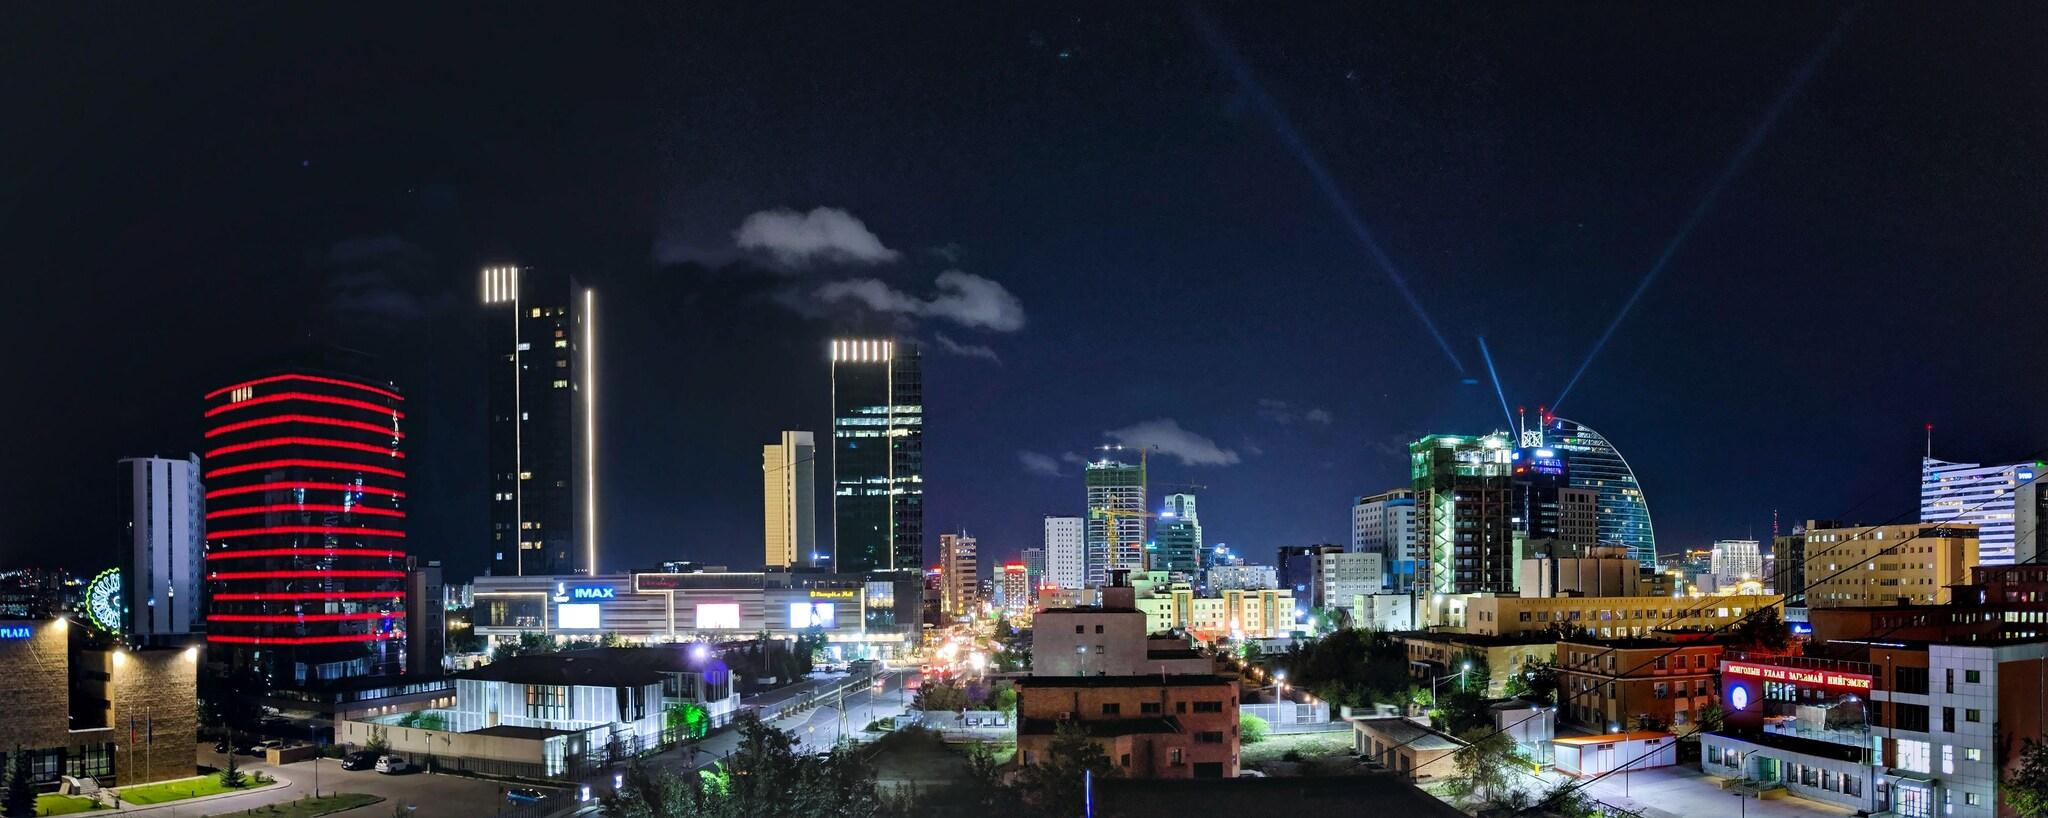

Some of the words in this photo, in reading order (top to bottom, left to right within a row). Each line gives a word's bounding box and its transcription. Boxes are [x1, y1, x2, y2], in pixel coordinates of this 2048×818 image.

[575, 588, 614, 598] IMAX
[0, 628, 30, 638] PLAZA
[1764, 669, 1785, 679] УЛААН
